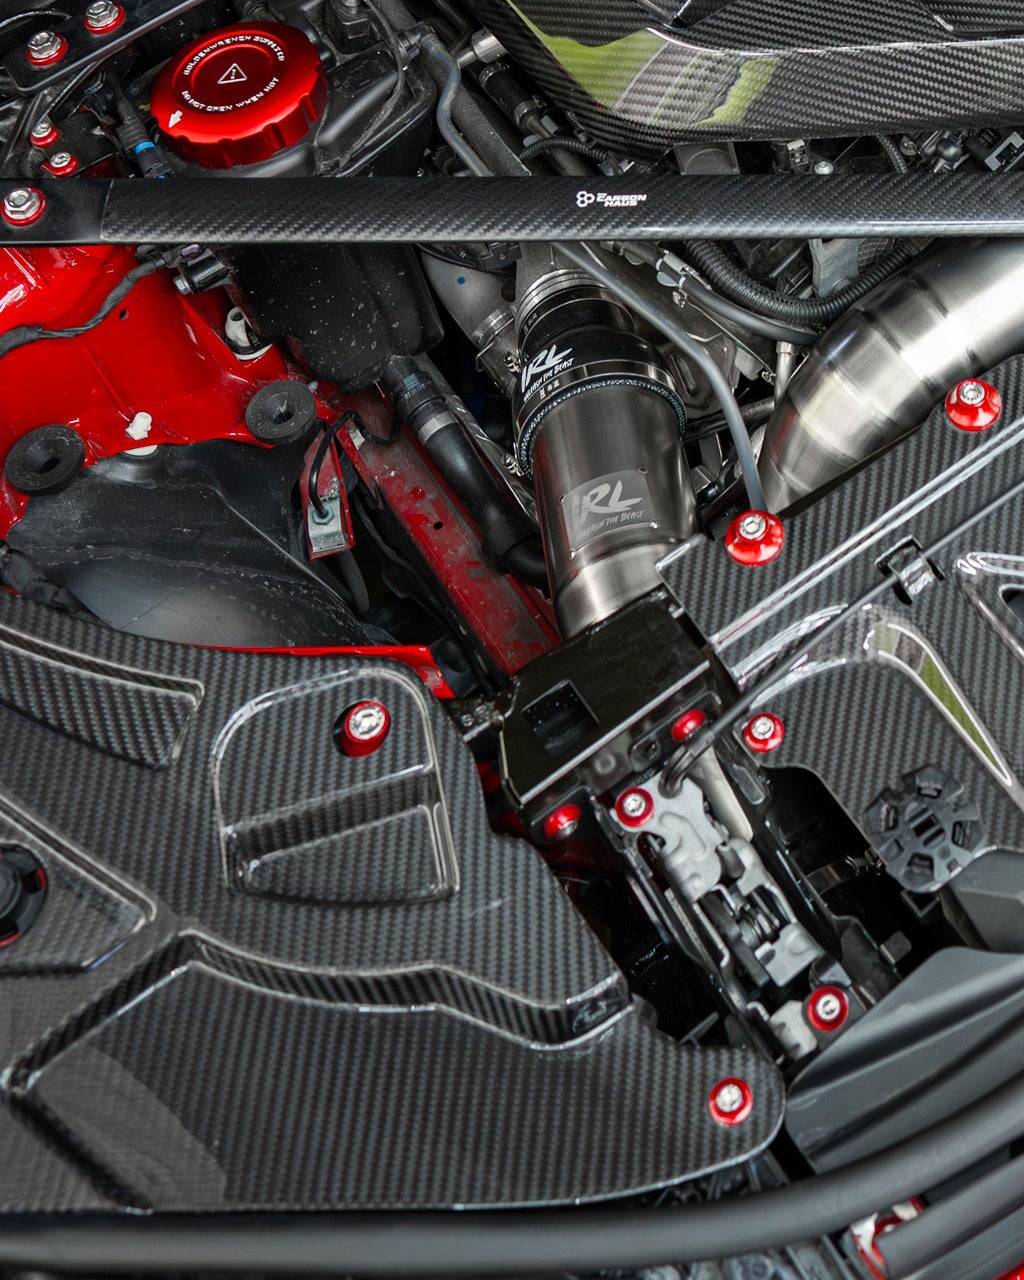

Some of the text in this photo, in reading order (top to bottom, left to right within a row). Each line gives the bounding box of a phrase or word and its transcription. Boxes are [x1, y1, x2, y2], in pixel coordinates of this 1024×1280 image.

[188, 98, 206, 110] NOT
[206, 104, 233, 112] OPEN
[235, 91, 265, 108] WHEN
[263, 76, 280, 93] HOT
[604, 200, 638, 208] HAUS
[554, 358, 575, 374] BEAST
[620, 510, 644, 522] BEAST
